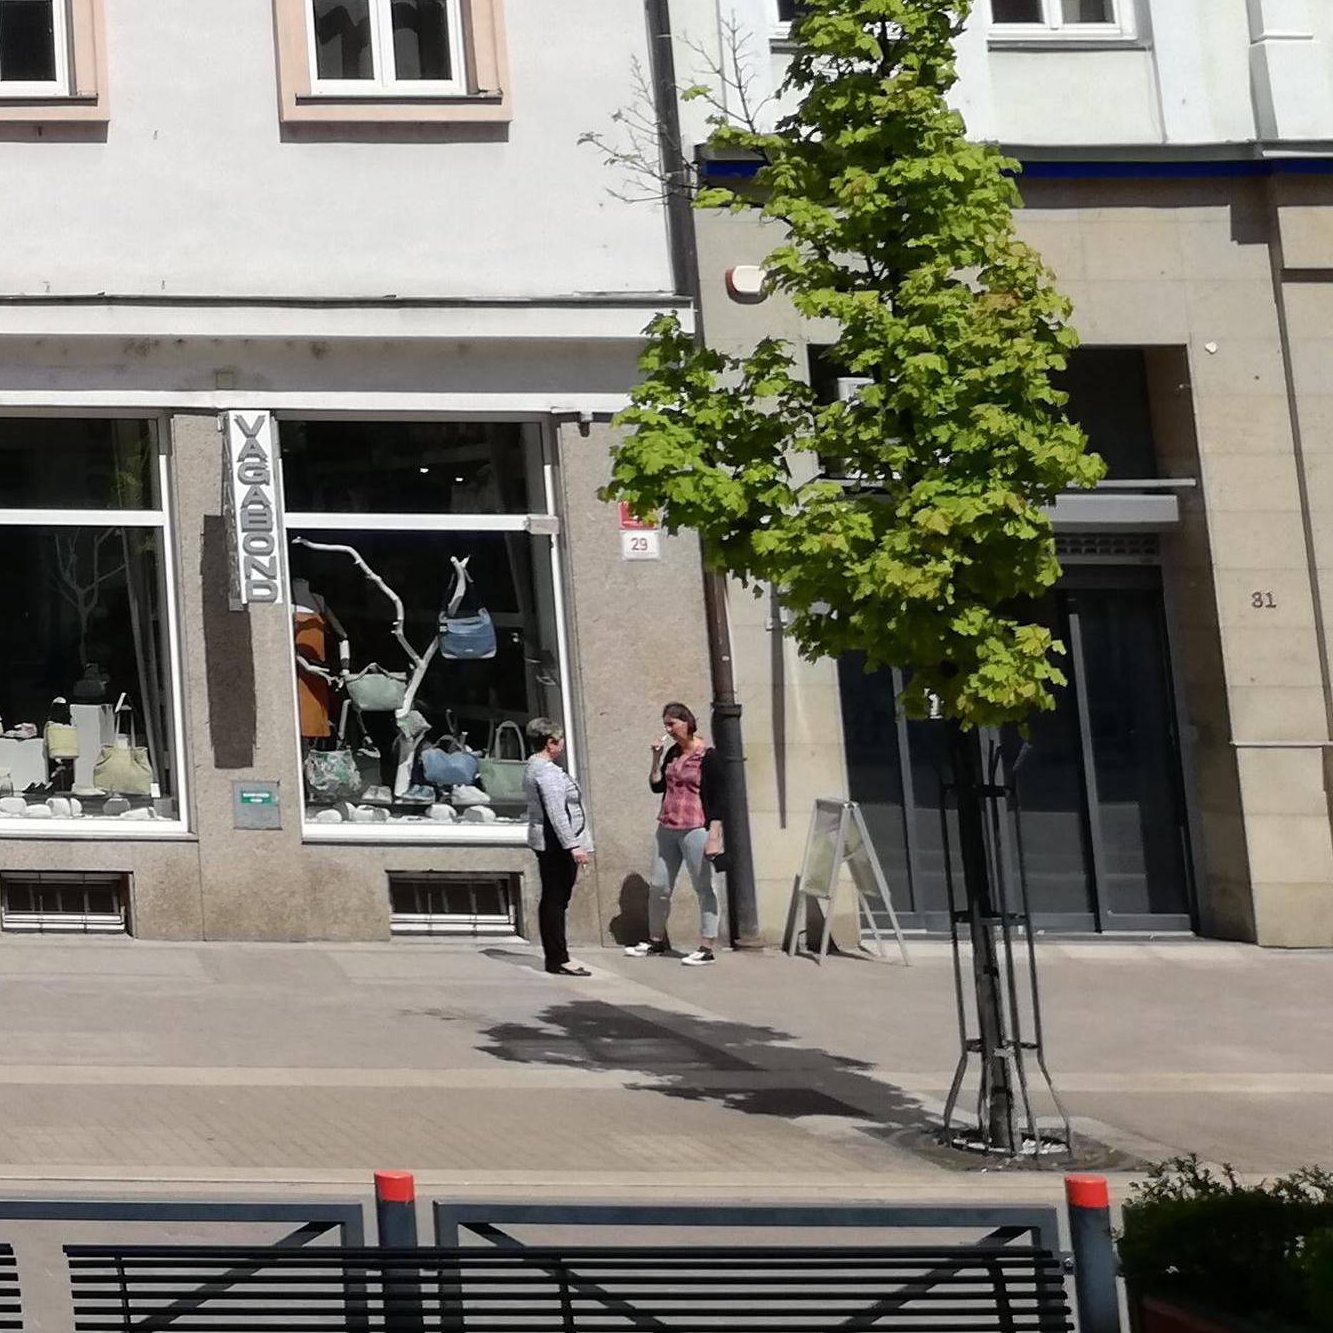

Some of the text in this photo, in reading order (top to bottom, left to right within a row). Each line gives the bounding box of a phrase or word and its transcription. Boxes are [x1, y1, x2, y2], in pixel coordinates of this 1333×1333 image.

[233, 414, 279, 604] VAGABOND
[631, 537, 648, 551] 29
[1252, 591, 1277, 608] 31
